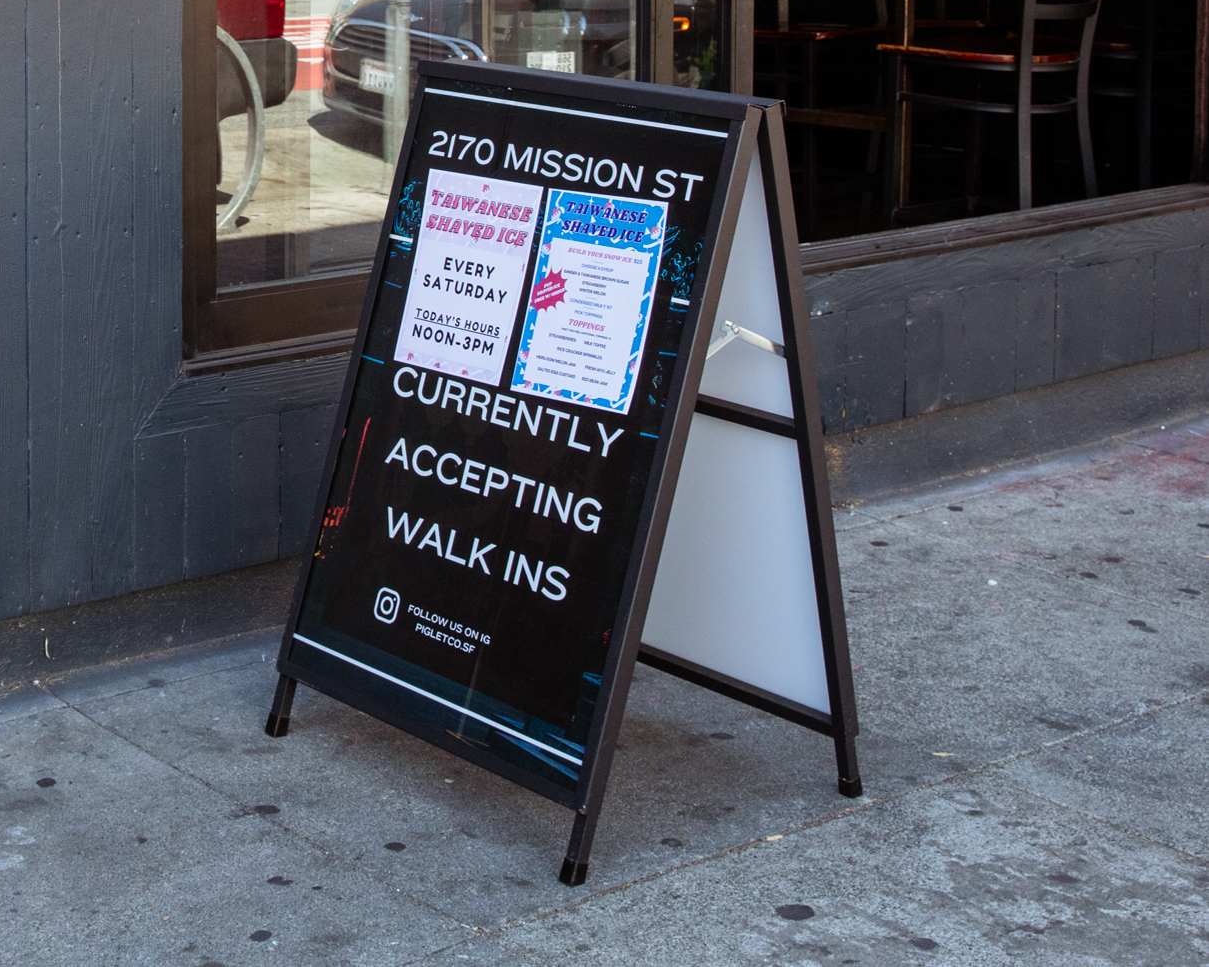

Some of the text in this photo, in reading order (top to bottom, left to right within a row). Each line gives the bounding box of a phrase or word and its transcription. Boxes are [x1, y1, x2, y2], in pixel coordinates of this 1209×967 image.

[428, 130, 704, 202] 2170 MISSION ST
[431, 189, 534, 223] TAIWANESE
[566, 201, 648, 224] TAIWANESE
[426, 214, 528, 247] SHAVED ICE
[562, 219, 645, 243] SHAVED ICE
[443, 256, 495, 279] EVERY
[568, 247, 587, 255] BUILD
[587, 250, 604, 258] YOUR
[603, 253, 622, 261] SNOW
[423, 274, 508, 304] SATURDAY
[582, 280, 607, 289] STRAWBERRY
[570, 297, 594, 307] CONDENSED
[583, 311, 603, 320] TOPPINGS
[415, 307, 501, 337] TODAY'S HOURS
[569, 318, 606, 332] TOPPINGS
[412, 323, 495, 356] NOON-3PM
[548, 332, 577, 343] STRAWBERRIES
[393, 366, 625, 458] CURRENTLY
[384, 437, 603, 534] ACCEPTING
[387, 506, 571, 601] WALK INS
[407, 604, 491, 645] FOLLOW US ON IG
[415, 622, 476, 654] PIGLETCO.SF
